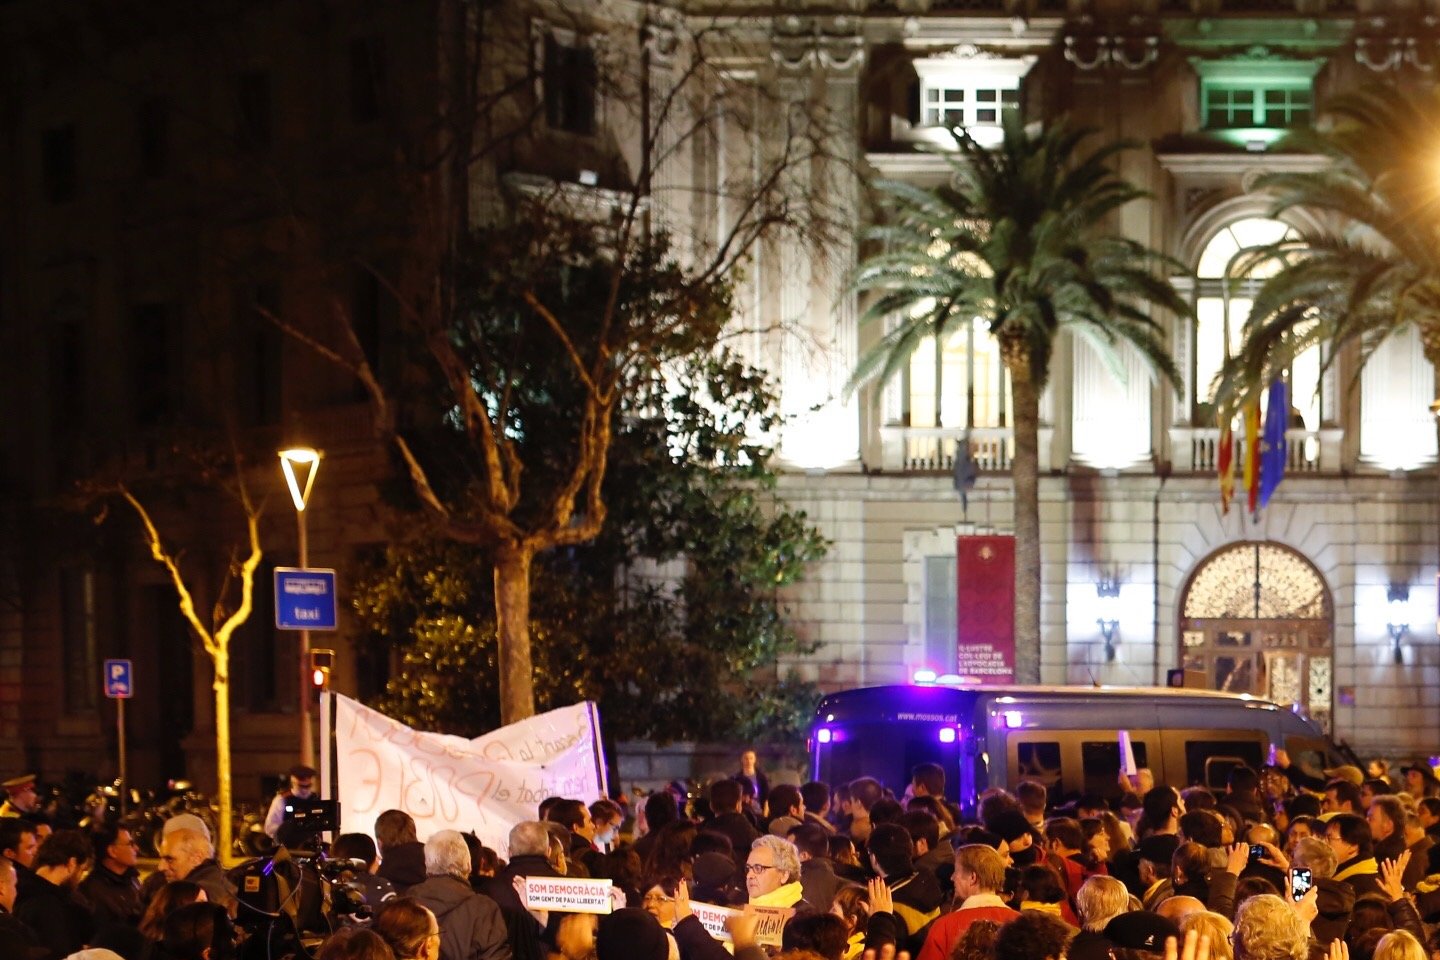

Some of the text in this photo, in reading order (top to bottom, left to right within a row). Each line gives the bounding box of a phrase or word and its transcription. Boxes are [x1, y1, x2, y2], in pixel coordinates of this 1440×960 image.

[111, 664, 125, 680] P
[529, 884, 605, 897] SOM DEMOCRÀCIA
[703, 910, 727, 924] DEMO
